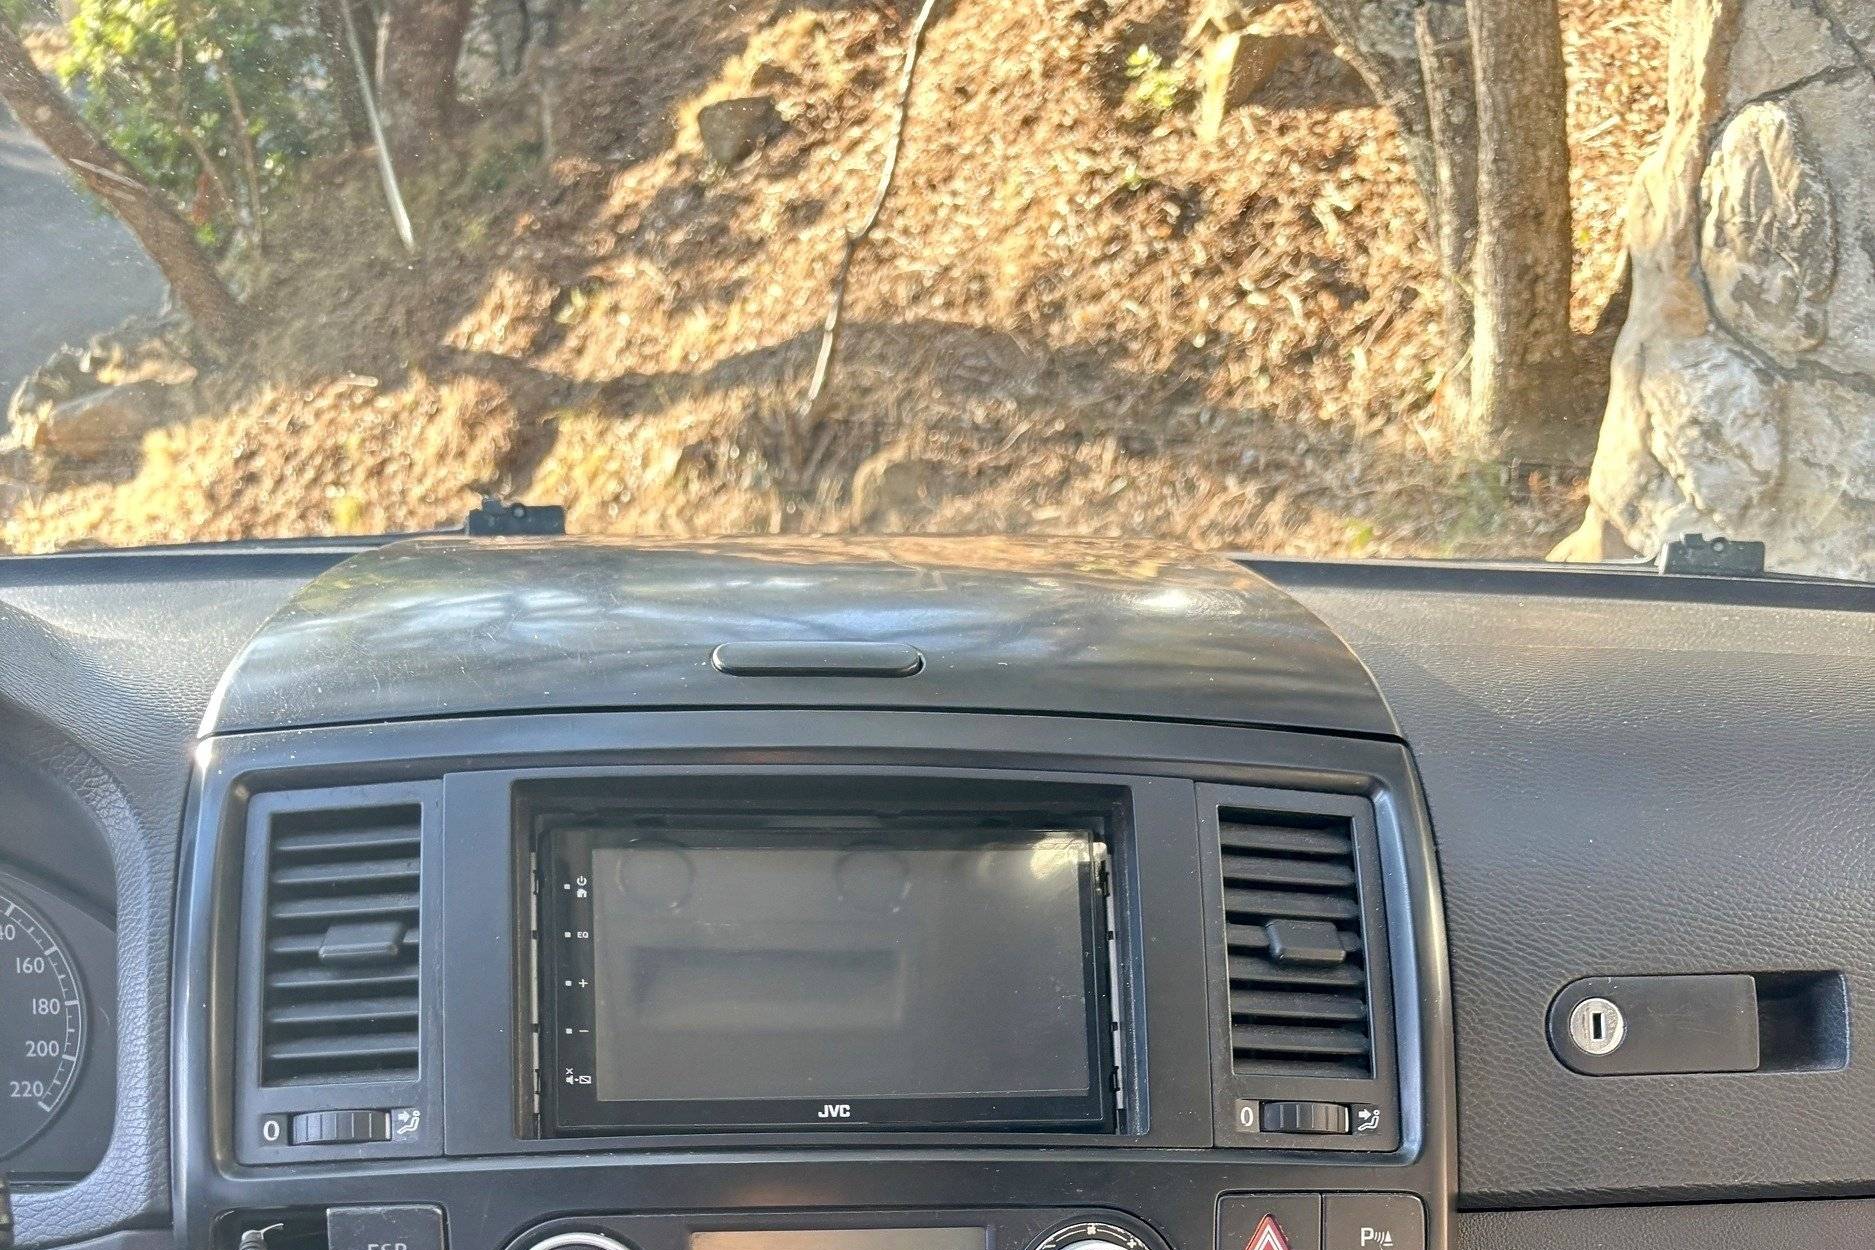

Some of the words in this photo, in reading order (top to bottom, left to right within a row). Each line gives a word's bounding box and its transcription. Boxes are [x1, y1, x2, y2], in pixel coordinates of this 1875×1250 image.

[577, 931, 589, 939] EQ
[16, 957, 45, 974] 160
[32, 998, 60, 1015] 180
[25, 1041, 60, 1057] 200
[10, 1082, 44, 1098] 220
[818, 1104, 851, 1118] JVC
[1240, 1107, 1254, 1128] 0
[263, 1120, 280, 1141] 0
